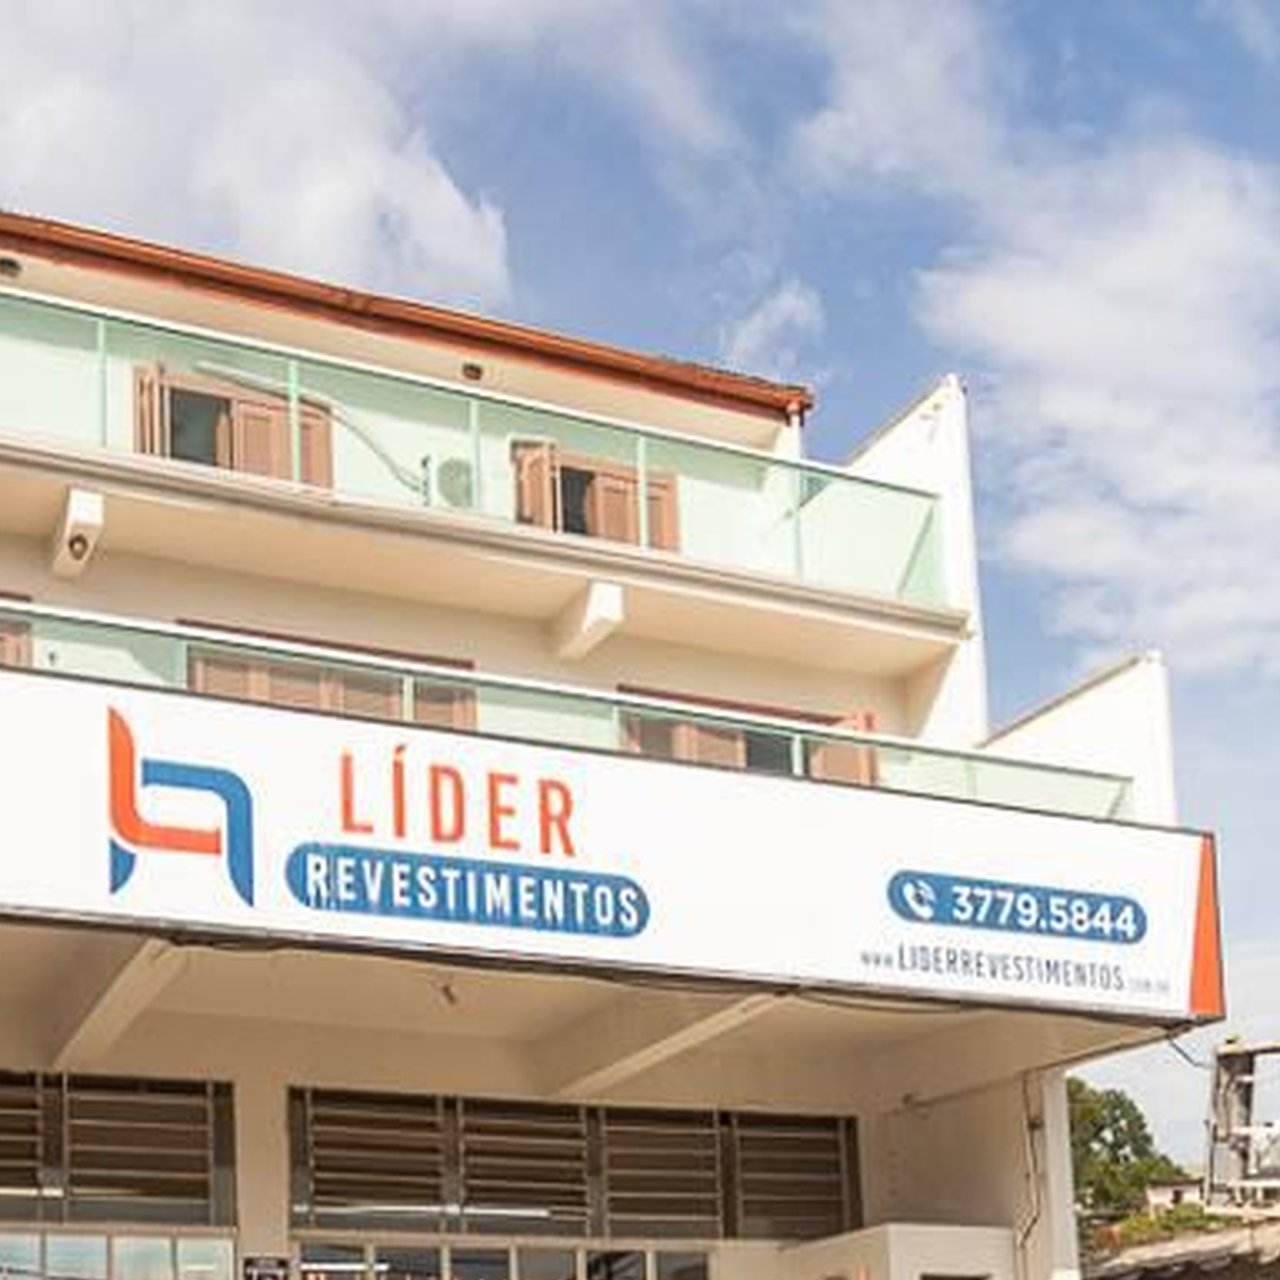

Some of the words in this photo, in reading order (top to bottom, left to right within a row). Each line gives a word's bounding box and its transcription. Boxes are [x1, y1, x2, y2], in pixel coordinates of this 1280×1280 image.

[339, 744, 576, 857] LÍDER
[305, 852, 641, 930] REVESTIMENTOS
[950, 885, 1137, 939] 3779.5844
